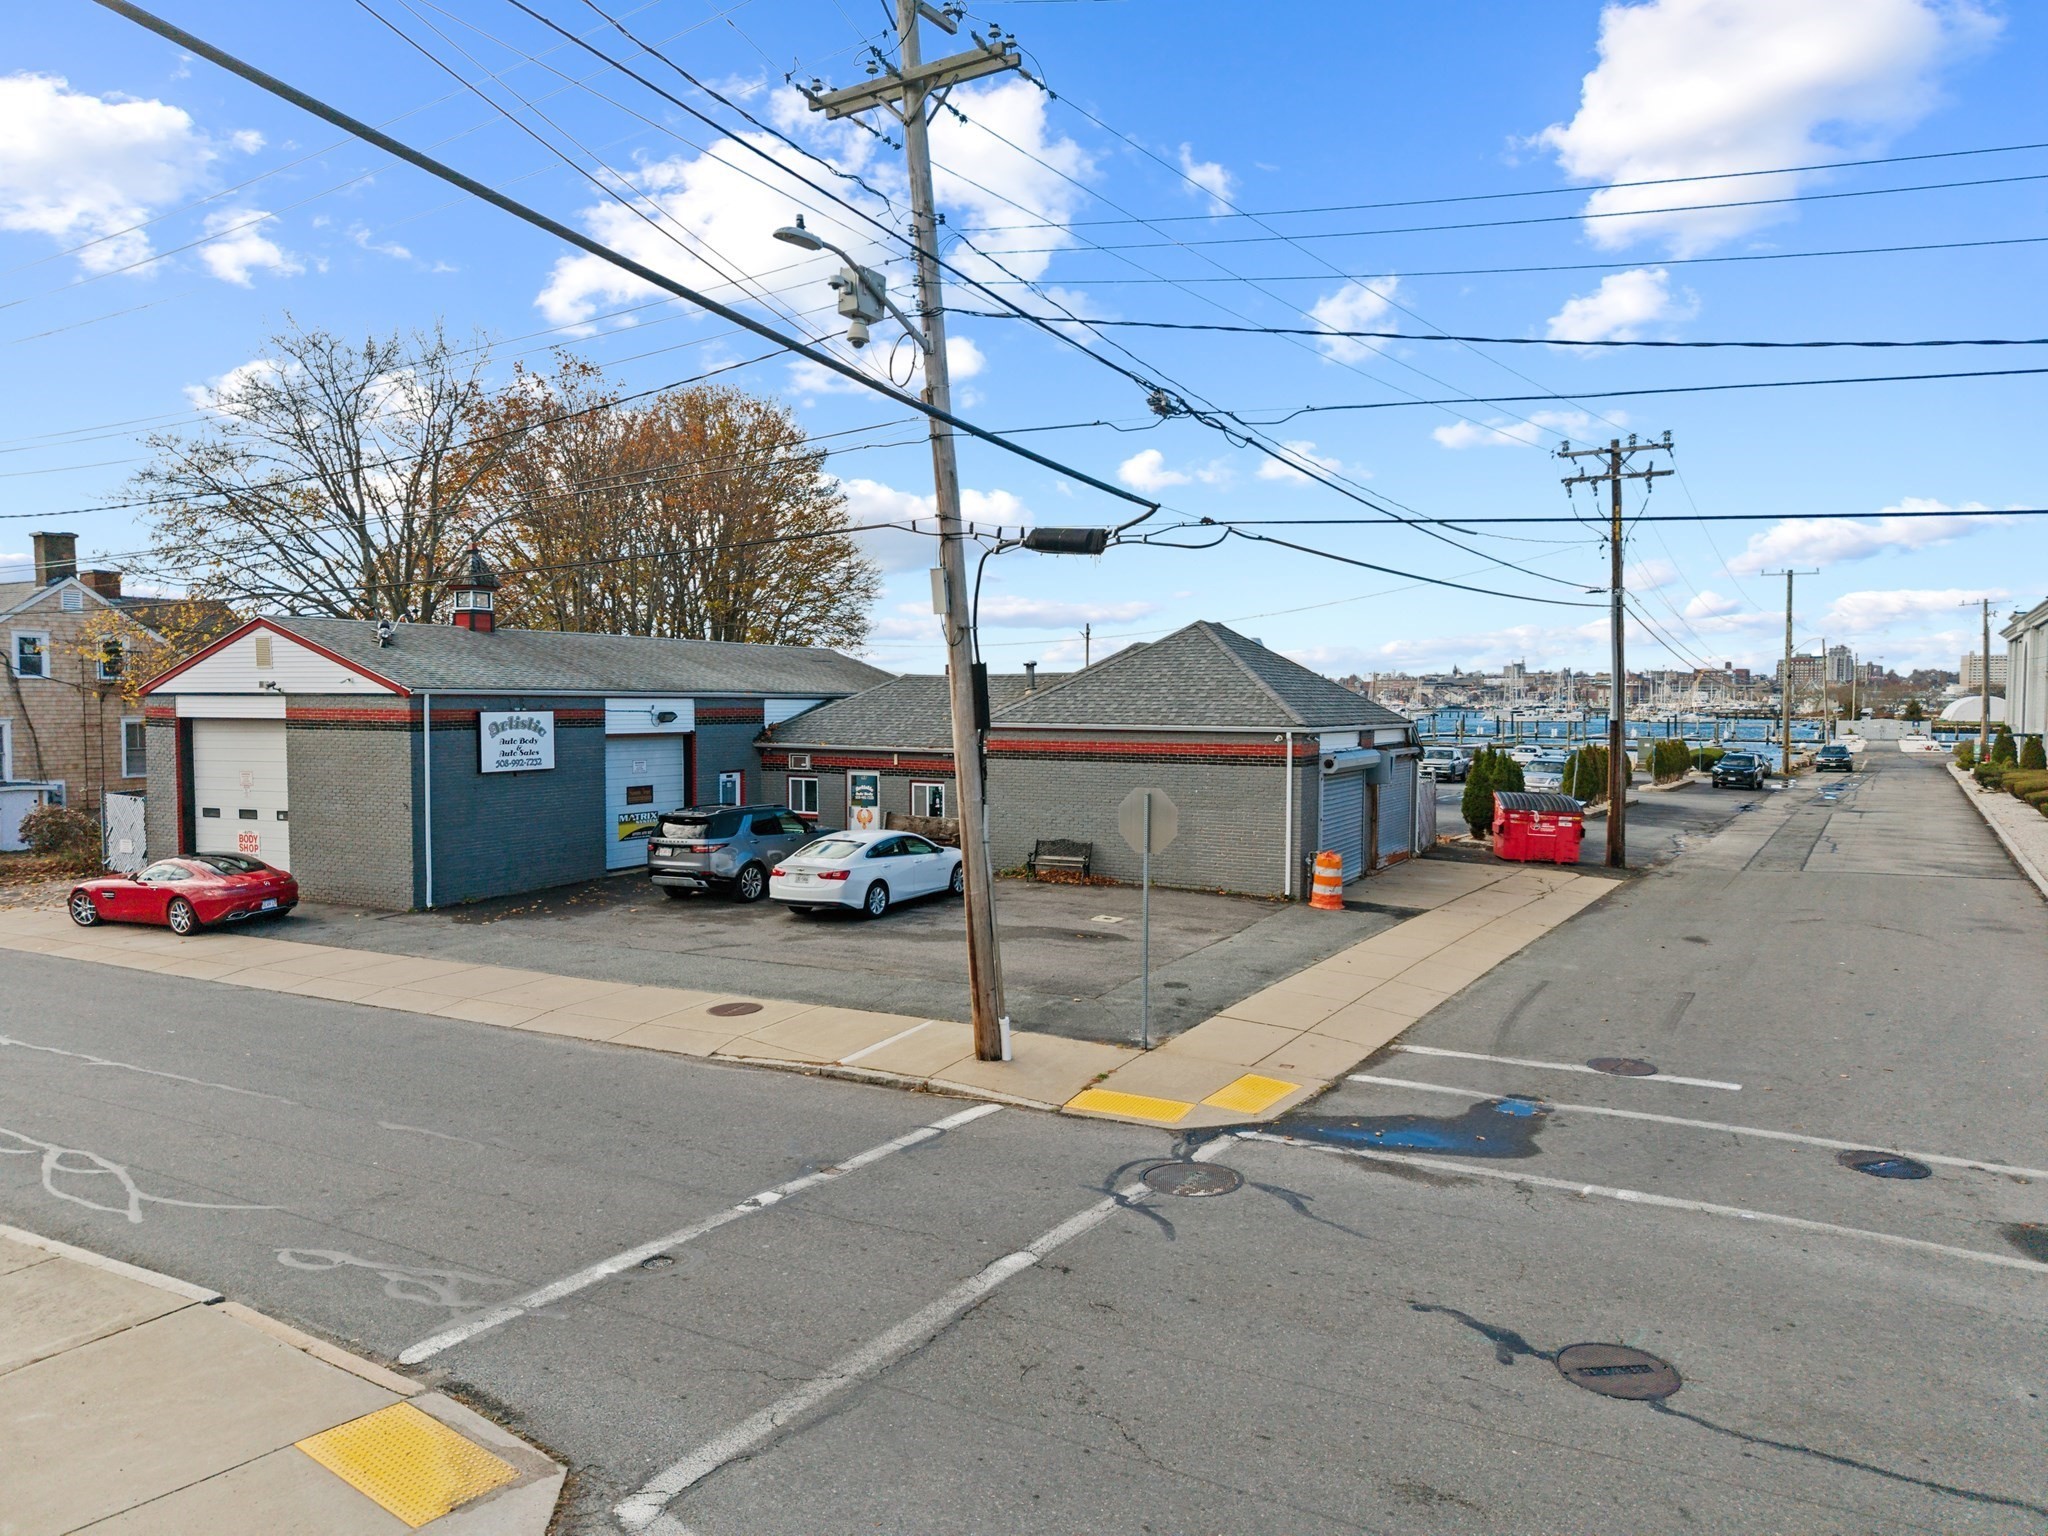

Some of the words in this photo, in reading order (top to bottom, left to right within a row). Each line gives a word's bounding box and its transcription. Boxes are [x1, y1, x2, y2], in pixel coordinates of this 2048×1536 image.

[488, 716, 547, 739] Artistic
[619, 812, 658, 822] MATRIX
[238, 834, 258, 843] BODY
[239, 843, 259, 853] SHOP
